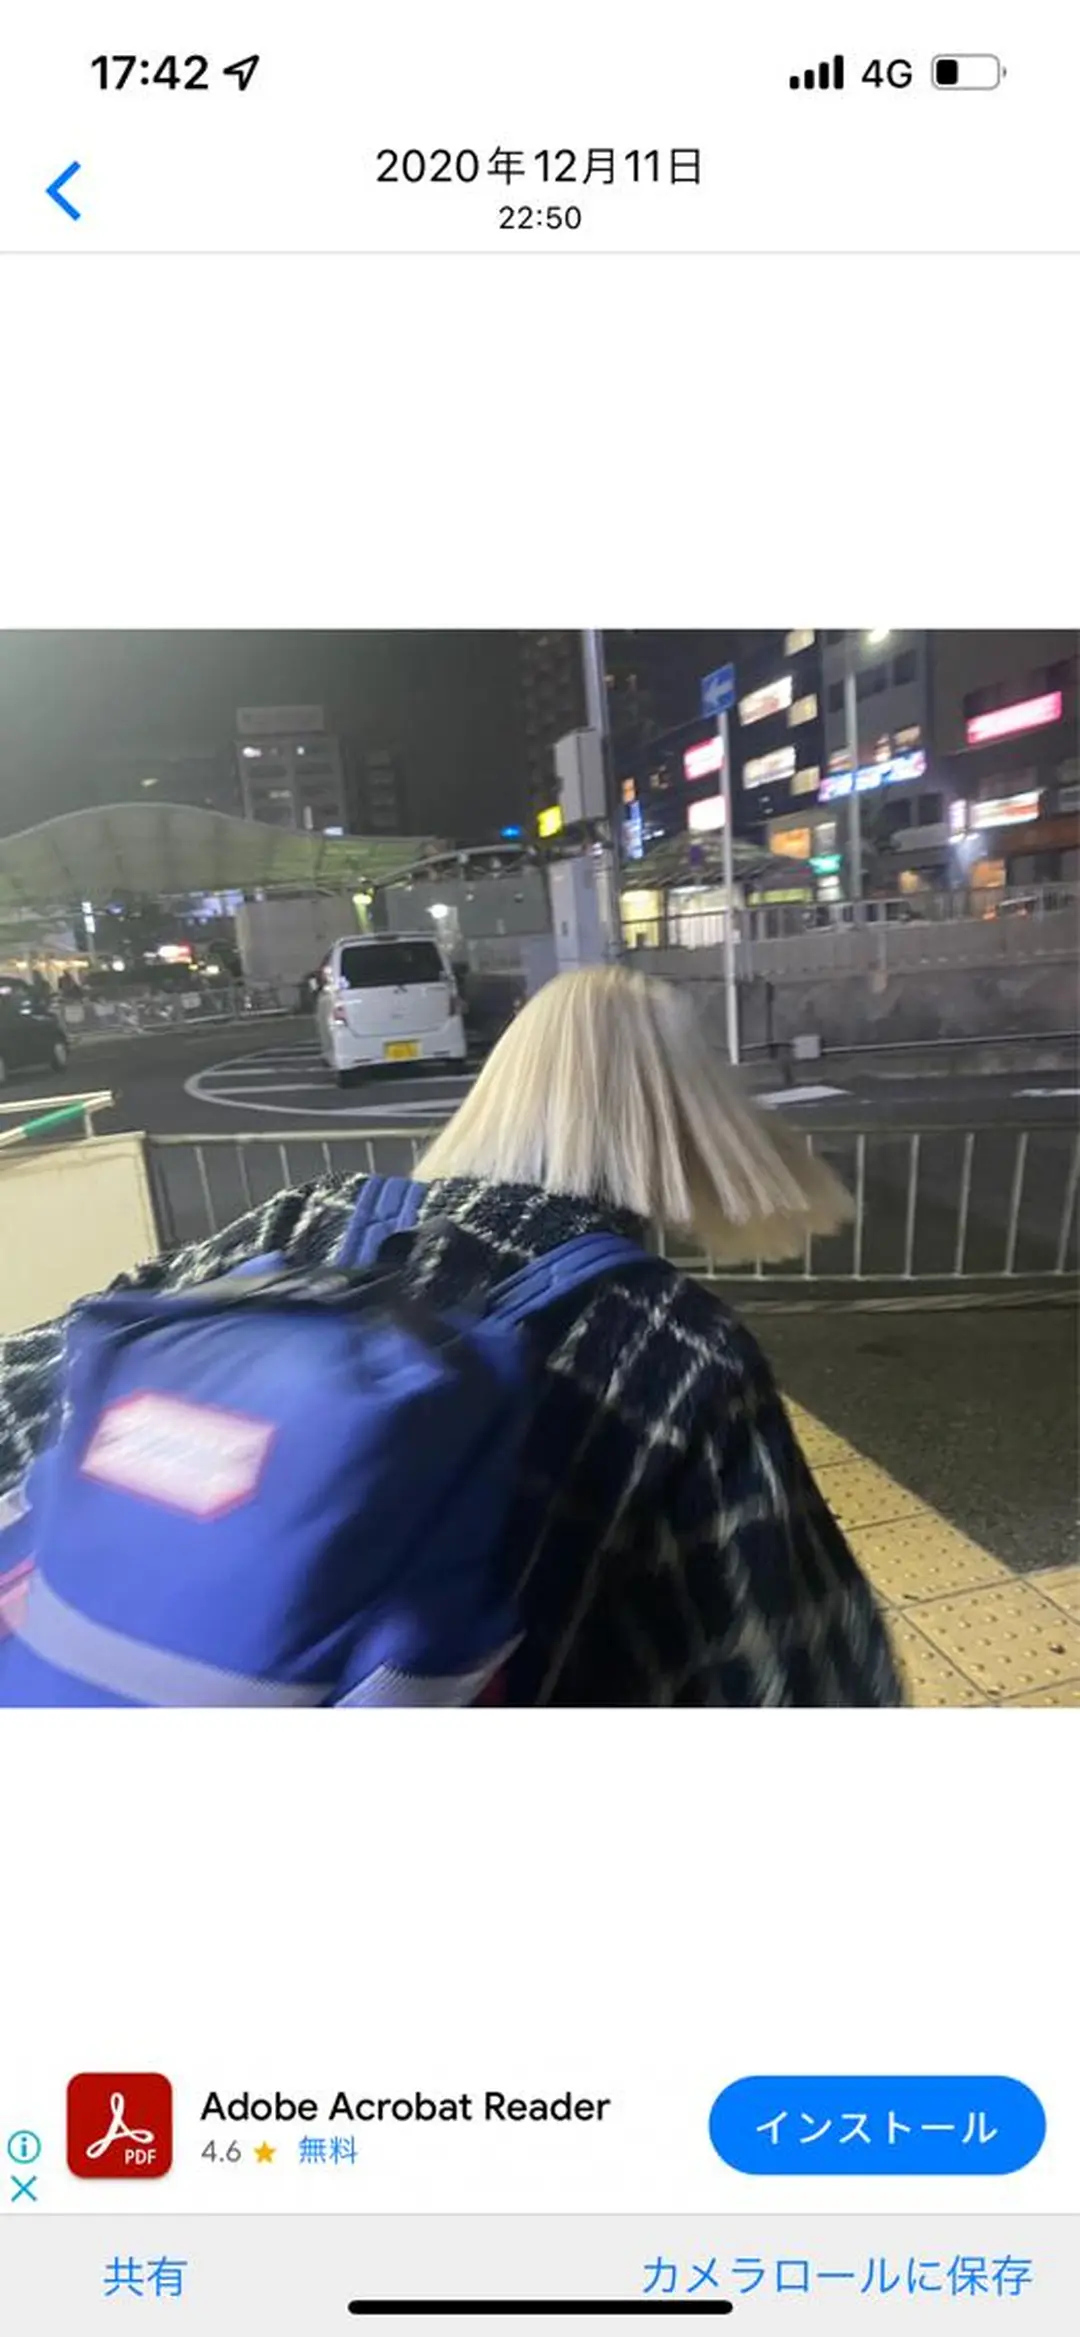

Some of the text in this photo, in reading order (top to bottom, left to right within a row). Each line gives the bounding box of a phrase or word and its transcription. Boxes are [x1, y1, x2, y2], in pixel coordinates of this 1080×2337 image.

[91, 55, 209, 91] 17:42
[861, 58, 912, 89] 4G
[376, 145, 703, 187] 2020年12月11日
[499, 205, 582, 230] 22:50
[200, 2091, 612, 2122] Adobe Acrobat Reader
[756, 2111, 998, 2145] インストール
[124, 2148, 157, 2165] PDF
[201, 2140, 241, 2164] 4.6
[298, 2135, 359, 2166] 無料
[103, 2256, 188, 2297] 共有
[642, 2254, 1033, 2297] カメラロールに保存
